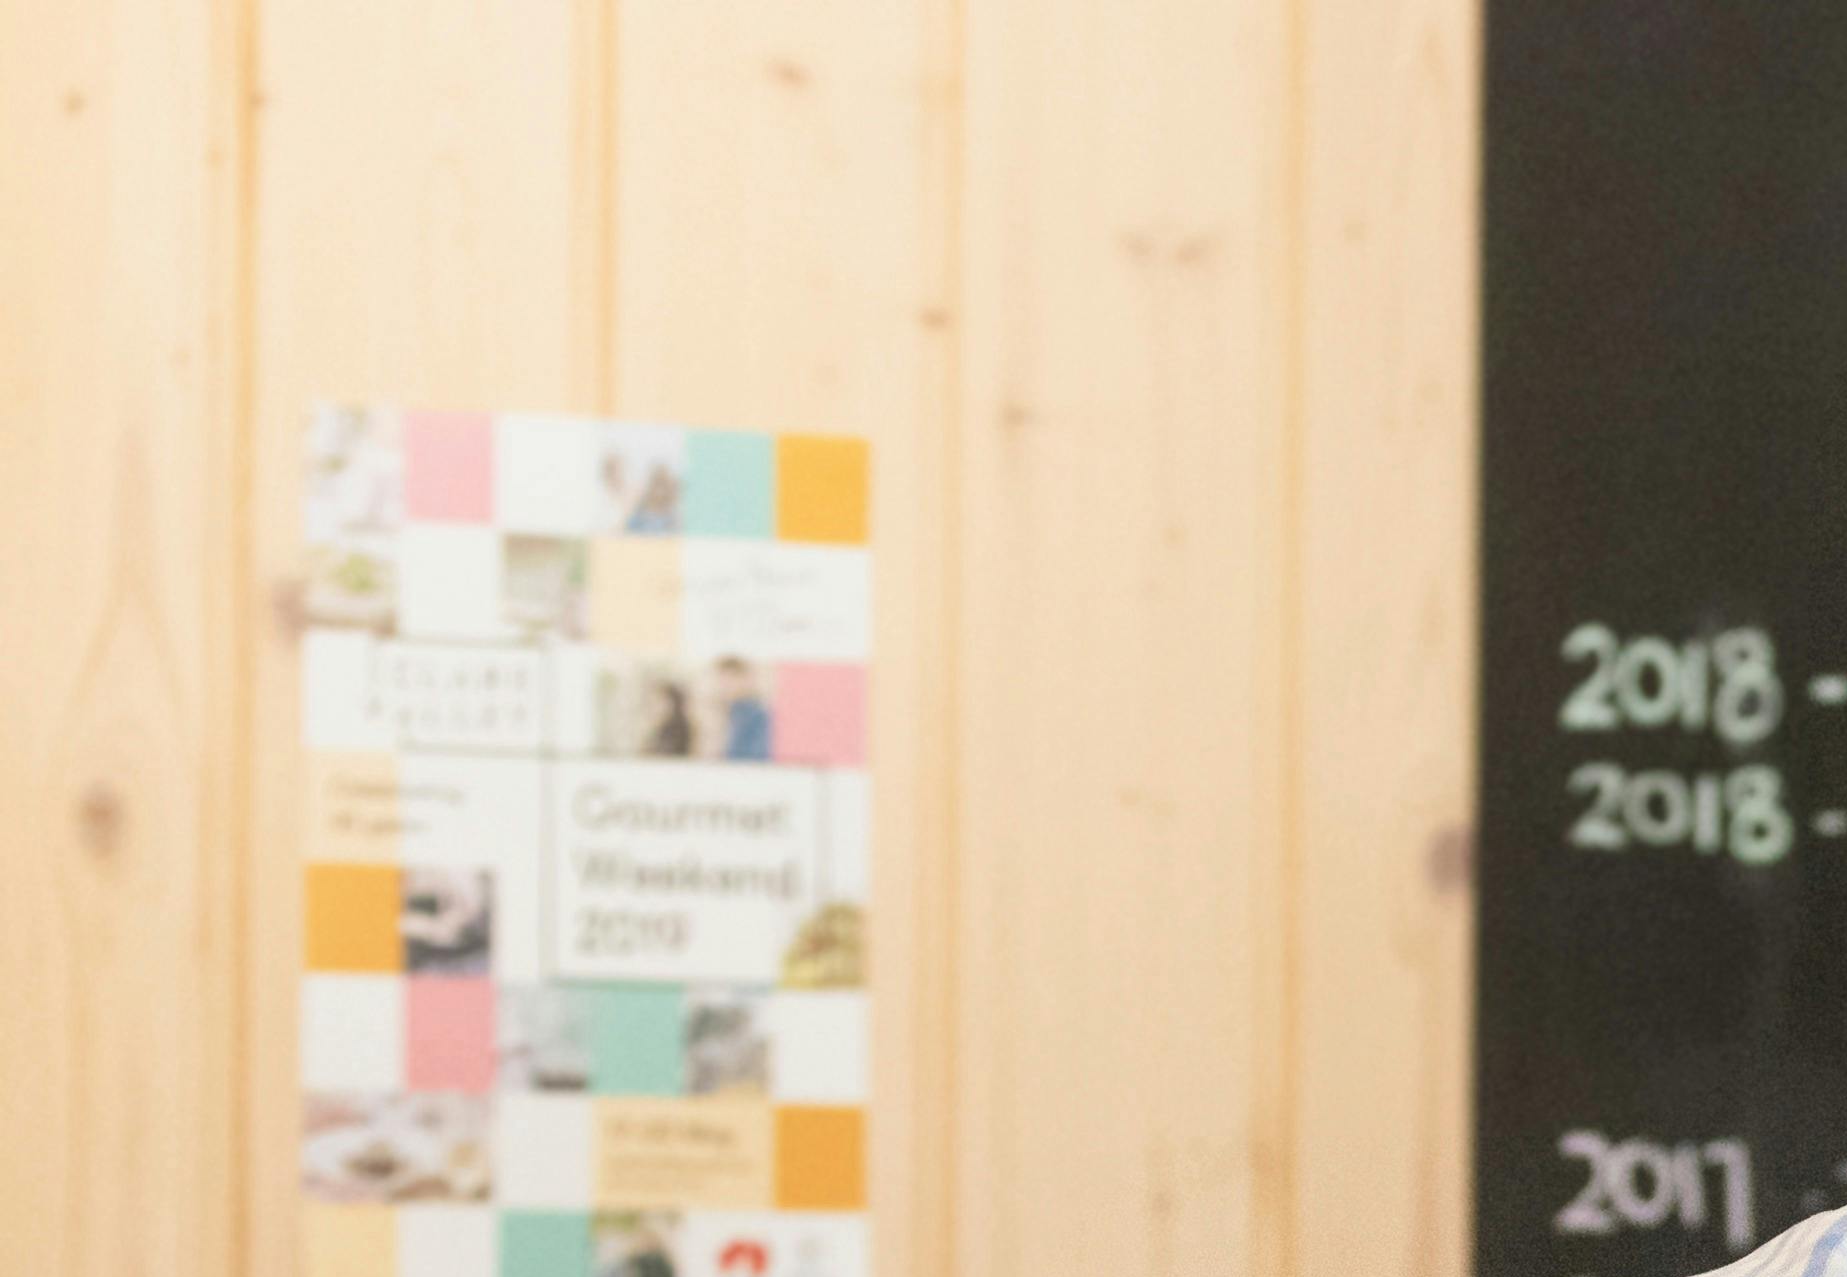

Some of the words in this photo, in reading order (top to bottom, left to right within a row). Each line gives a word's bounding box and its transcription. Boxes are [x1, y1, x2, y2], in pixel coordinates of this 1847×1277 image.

[1560, 622, 1785, 745] 2018
[1568, 762, 1794, 863] 2018
[1553, 1128, 1755, 1250] 2017
